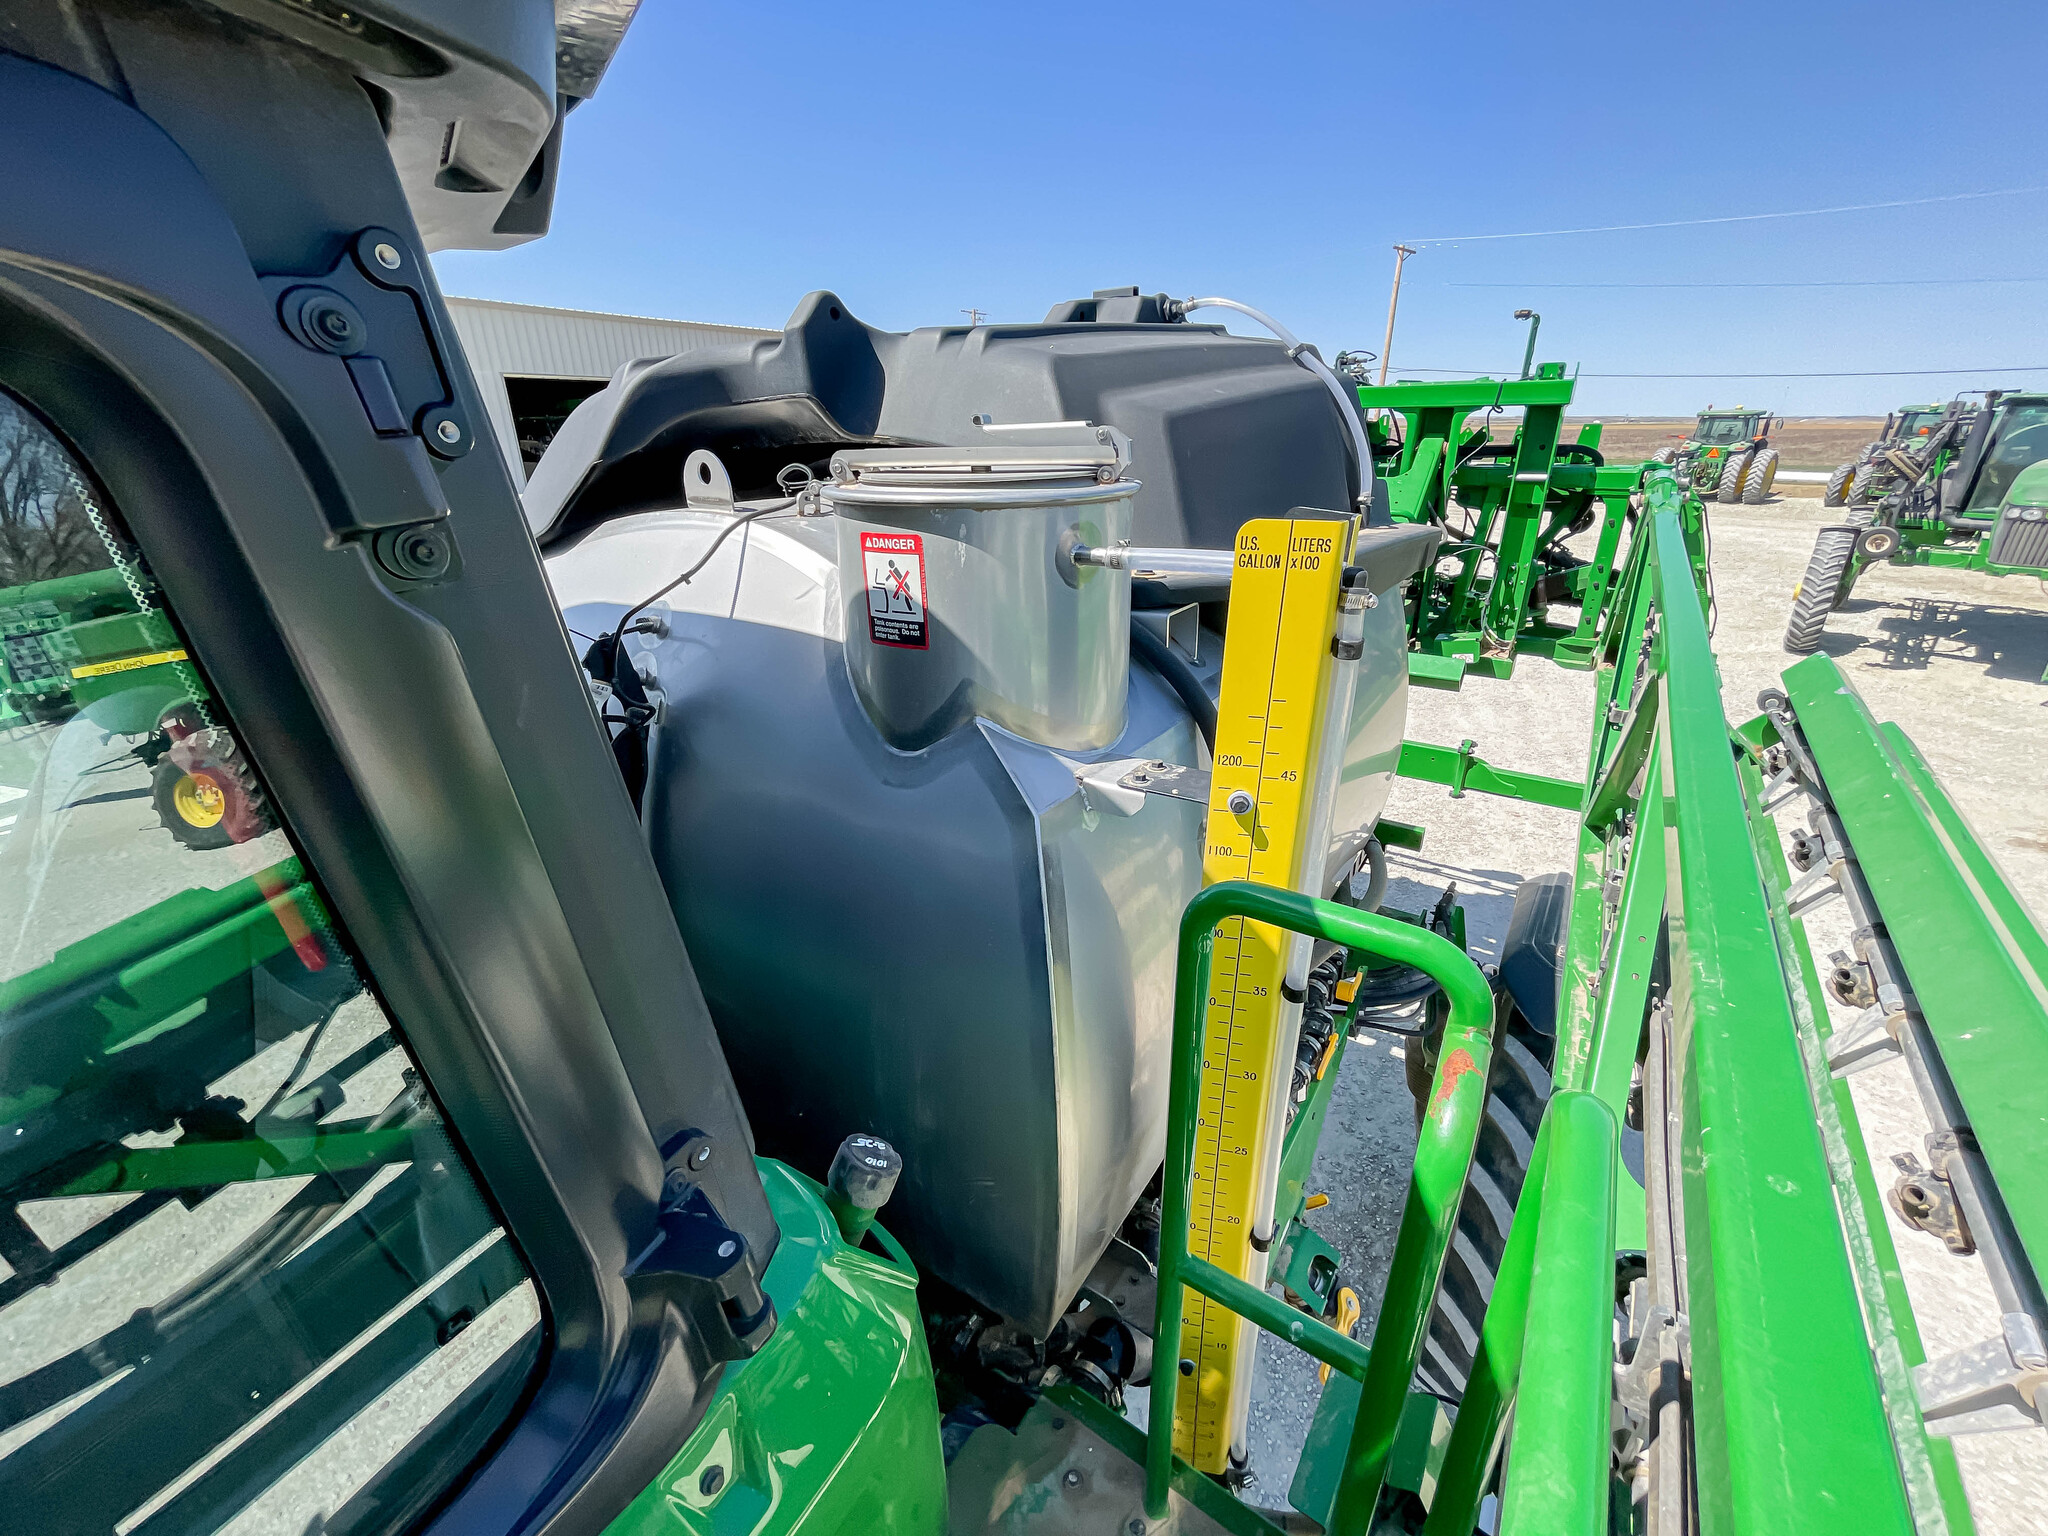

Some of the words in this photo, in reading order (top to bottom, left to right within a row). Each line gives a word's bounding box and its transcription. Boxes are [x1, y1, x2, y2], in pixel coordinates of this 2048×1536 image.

[872, 538, 915, 550] DANGER
[1240, 536, 1260, 551] U.S.
[1292, 537, 1332, 553] LITERS
[1238, 554, 1281, 569] GALLON
[874, 618, 885, 626] Tank
[886, 621, 908, 629] contents
[888, 633, 900, 641] tank.
[1217, 754, 1242, 767] 1200
[1281, 770, 1297, 782] 45
[1208, 845, 1232, 857] 1100
[1252, 986, 1267, 997] 35
[1242, 1072, 1257, 1081] 30
[1234, 1147, 1248, 1156] 25
[1227, 1216, 1240, 1225] 20
